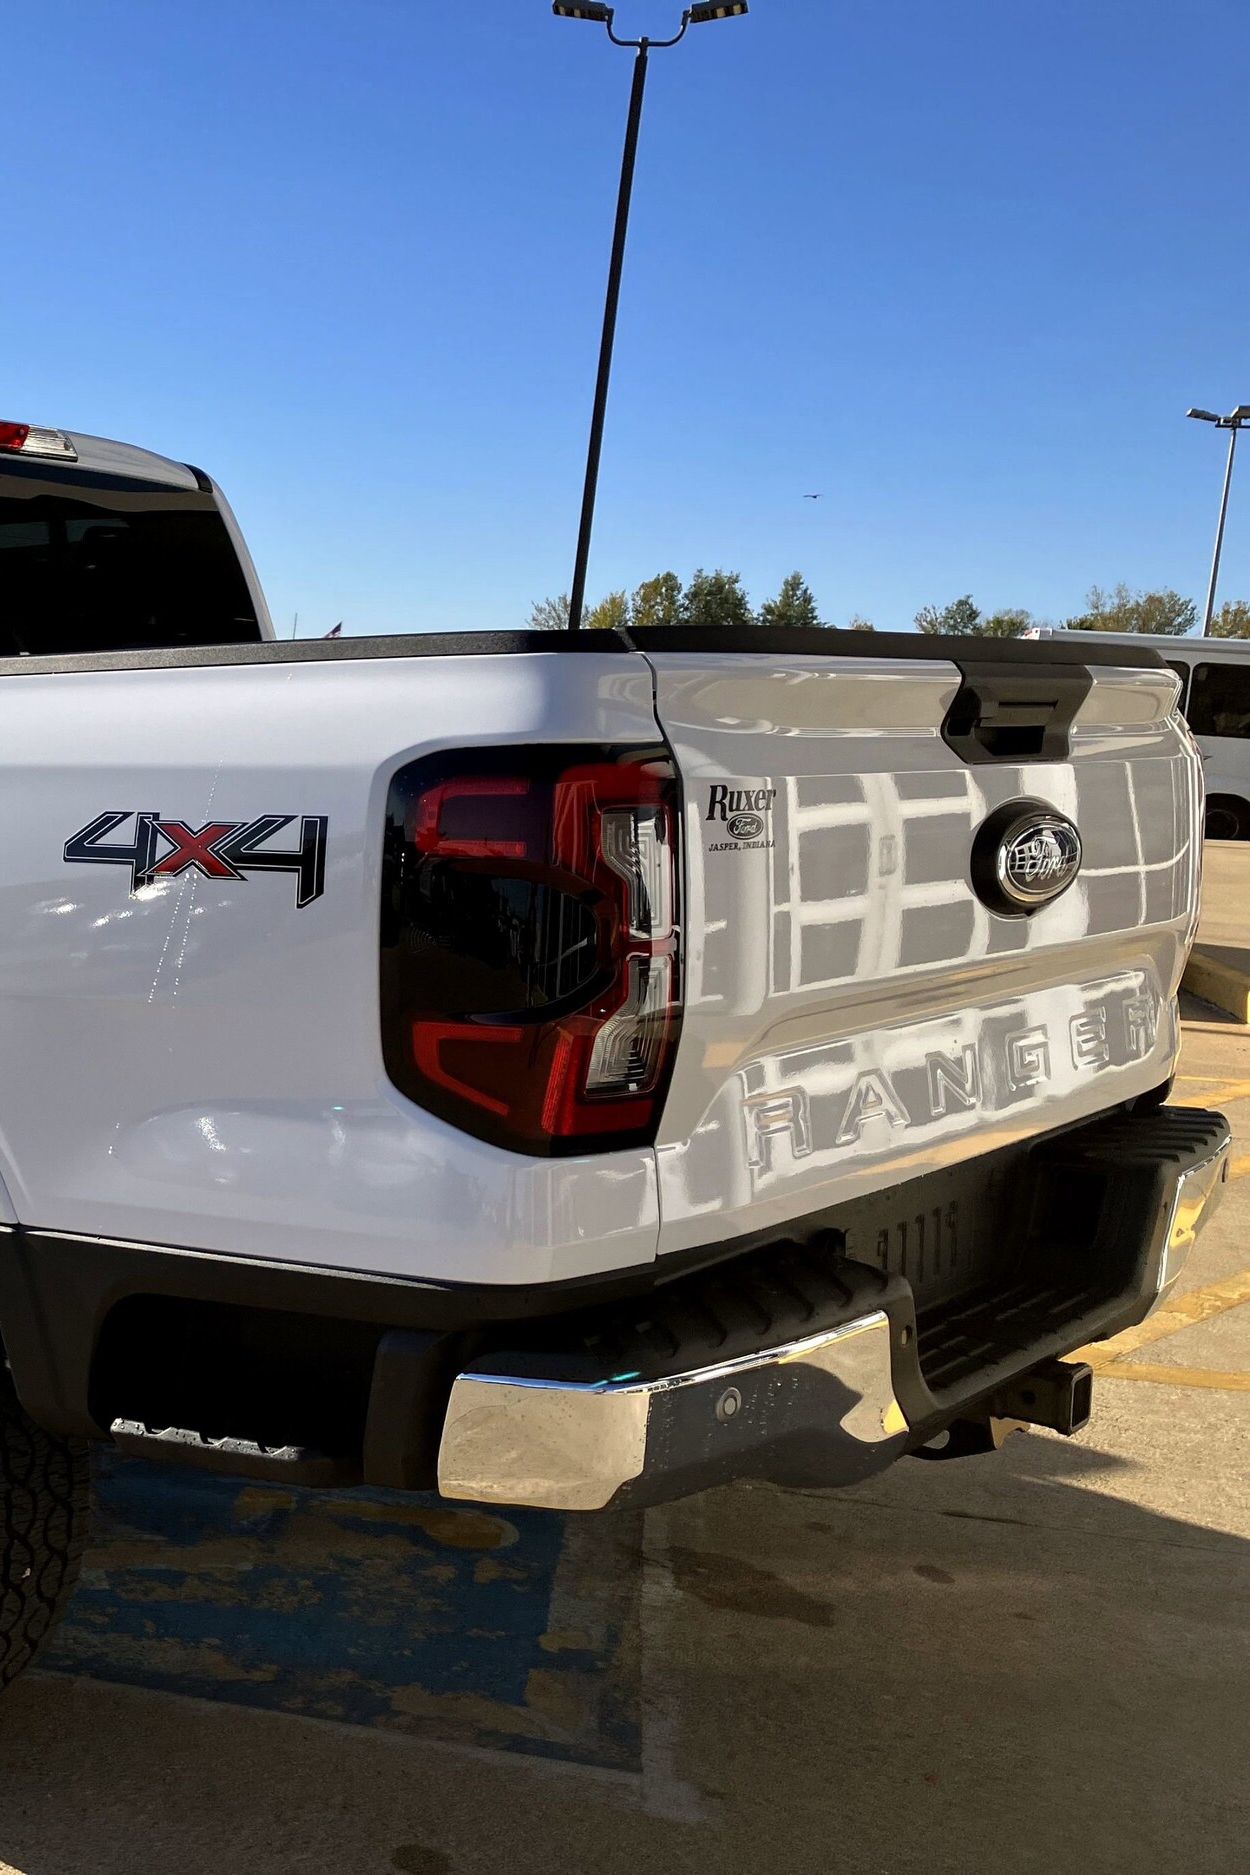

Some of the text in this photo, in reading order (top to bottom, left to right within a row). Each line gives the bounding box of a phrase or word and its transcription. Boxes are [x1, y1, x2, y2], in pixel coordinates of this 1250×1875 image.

[705, 784, 777, 821] Ruxer
[708, 841, 741, 852] JASPER,
[744, 998, 1156, 1170] RANGER
